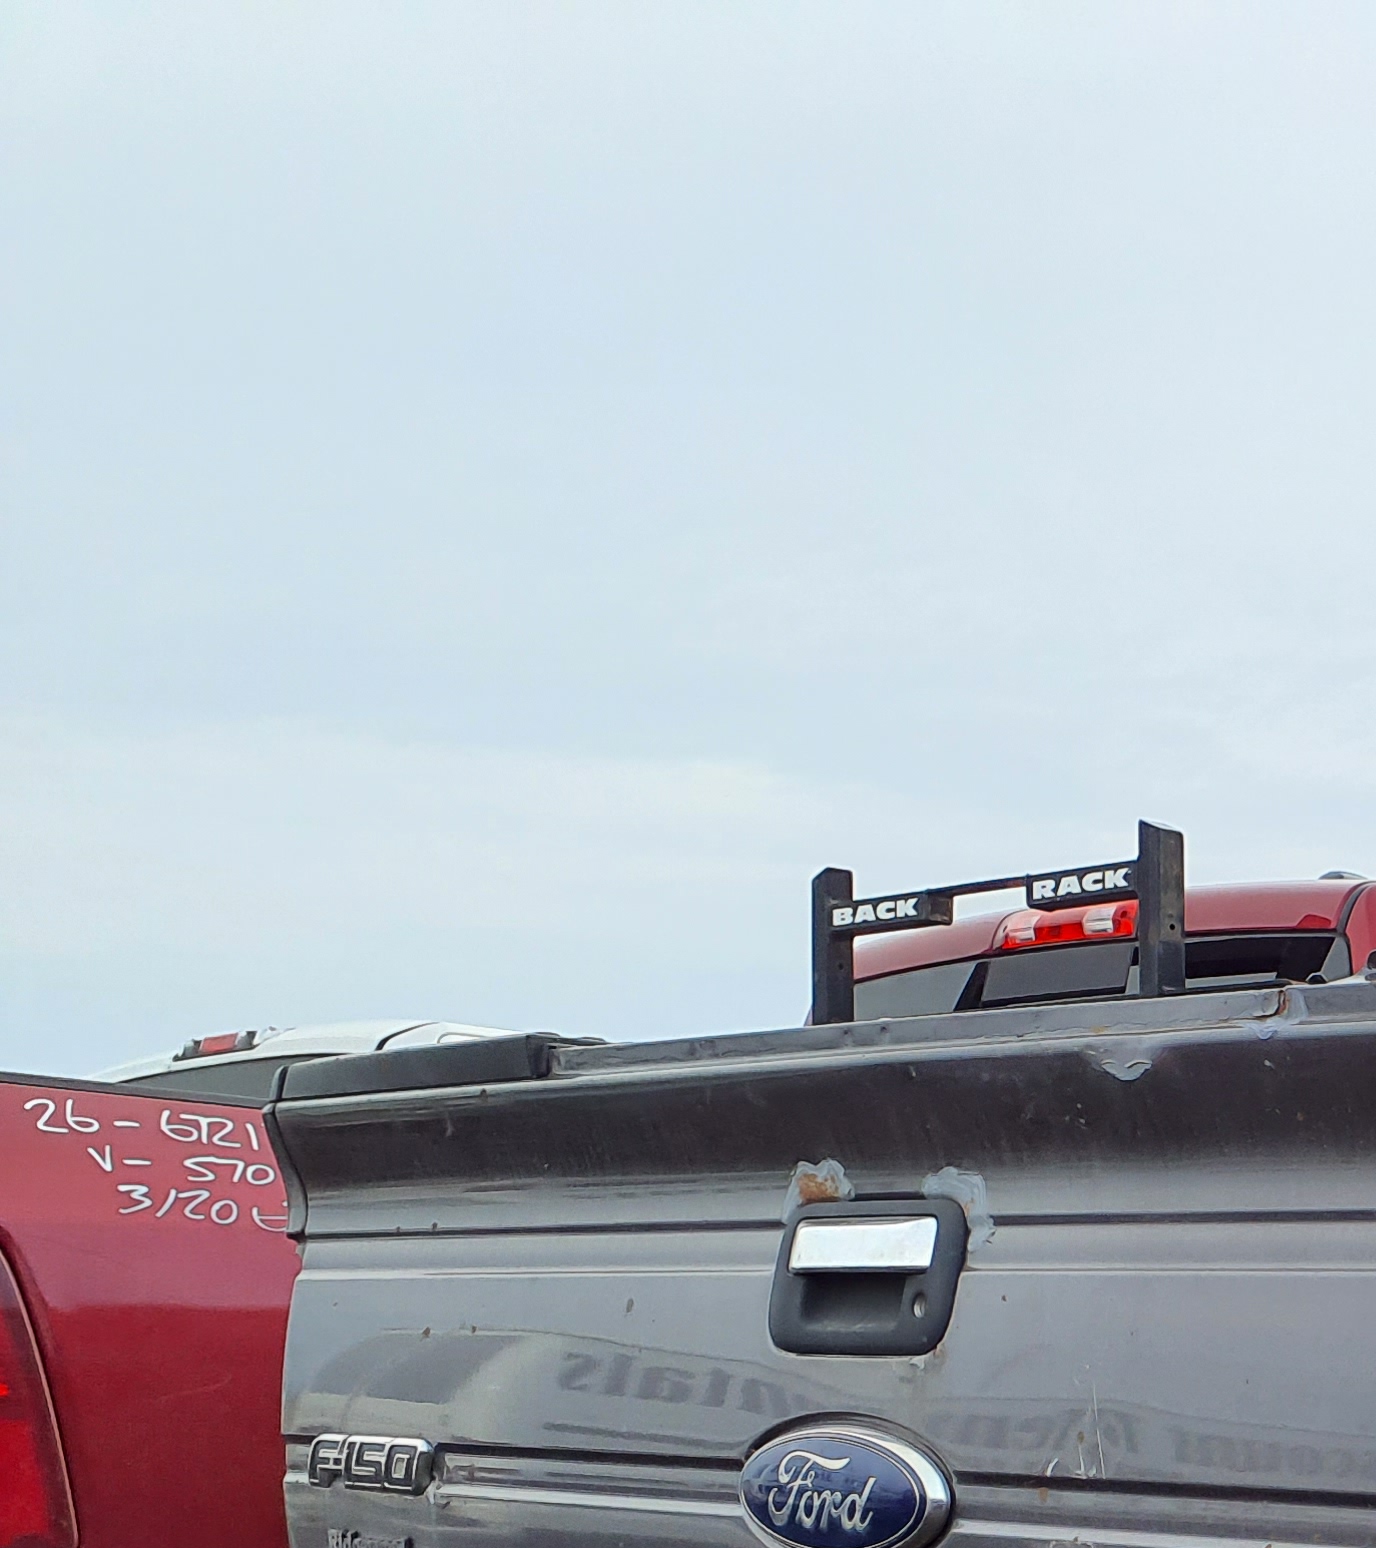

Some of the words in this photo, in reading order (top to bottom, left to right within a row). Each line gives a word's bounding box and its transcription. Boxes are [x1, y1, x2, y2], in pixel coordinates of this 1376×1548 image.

[831, 897, 919, 927] BACK
[1031, 867, 1131, 901] RACK
[308, 1433, 434, 1495] F-150
[768, 1450, 877, 1532] Ford
